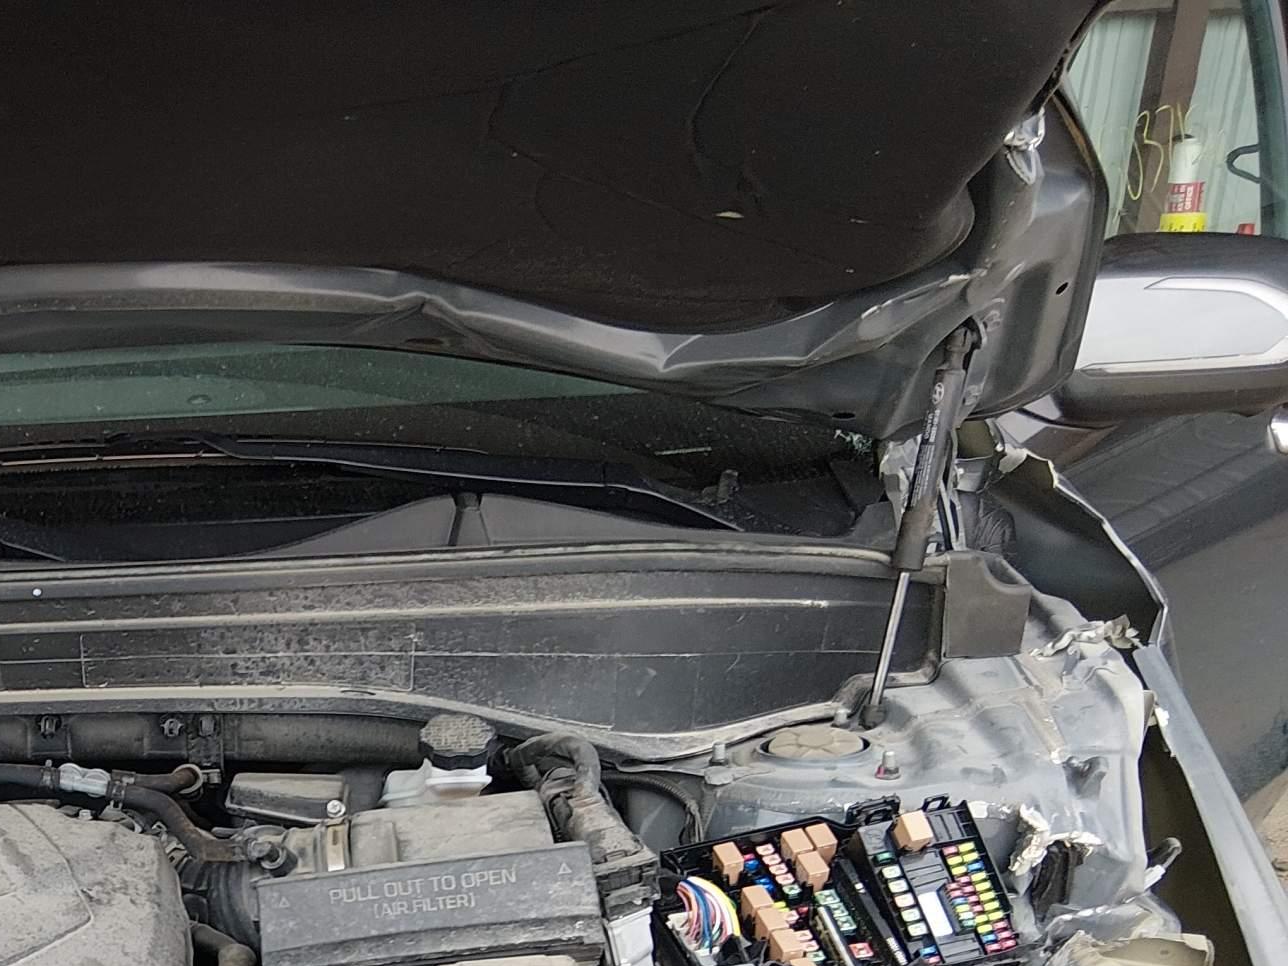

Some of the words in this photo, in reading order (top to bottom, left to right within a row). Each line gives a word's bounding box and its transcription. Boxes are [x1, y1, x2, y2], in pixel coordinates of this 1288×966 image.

[328, 884, 380, 904] PULL
[383, 879, 424, 898] OUT
[429, 875, 457, 892] TO
[462, 867, 518, 888] OPEN
